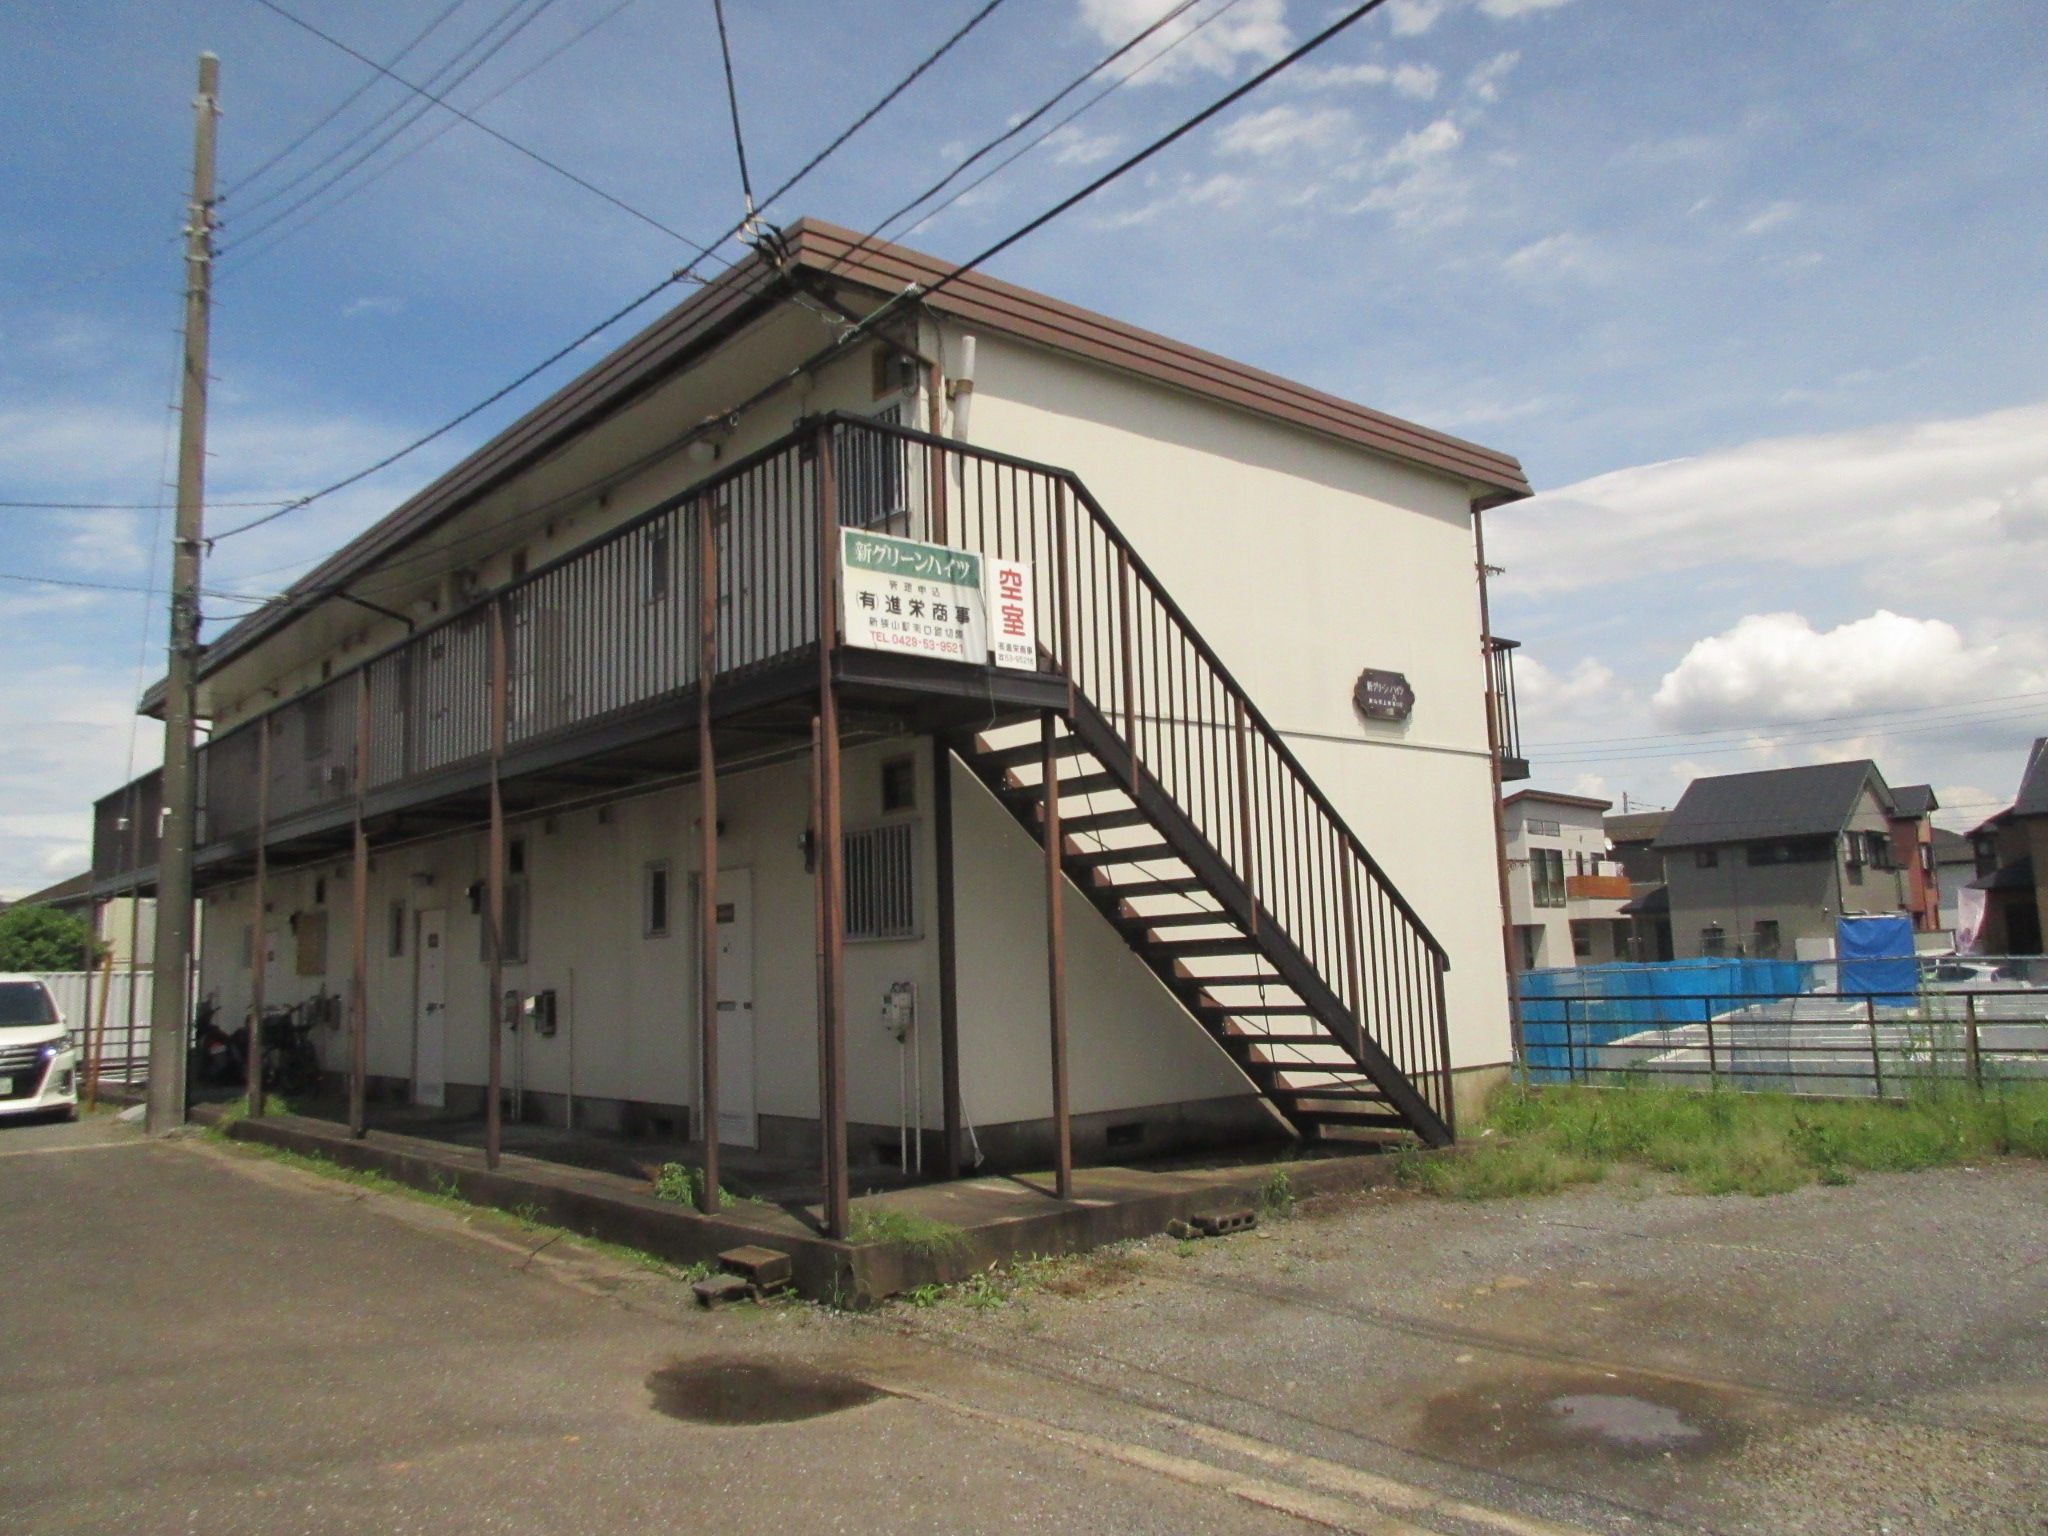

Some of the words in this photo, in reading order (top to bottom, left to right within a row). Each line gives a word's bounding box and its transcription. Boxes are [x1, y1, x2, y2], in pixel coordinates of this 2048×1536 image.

[855, 541, 970, 579] 新グリーンハイツ
[999, 568, 1026, 637] 空室
[869, 630, 889, 643] TEL
